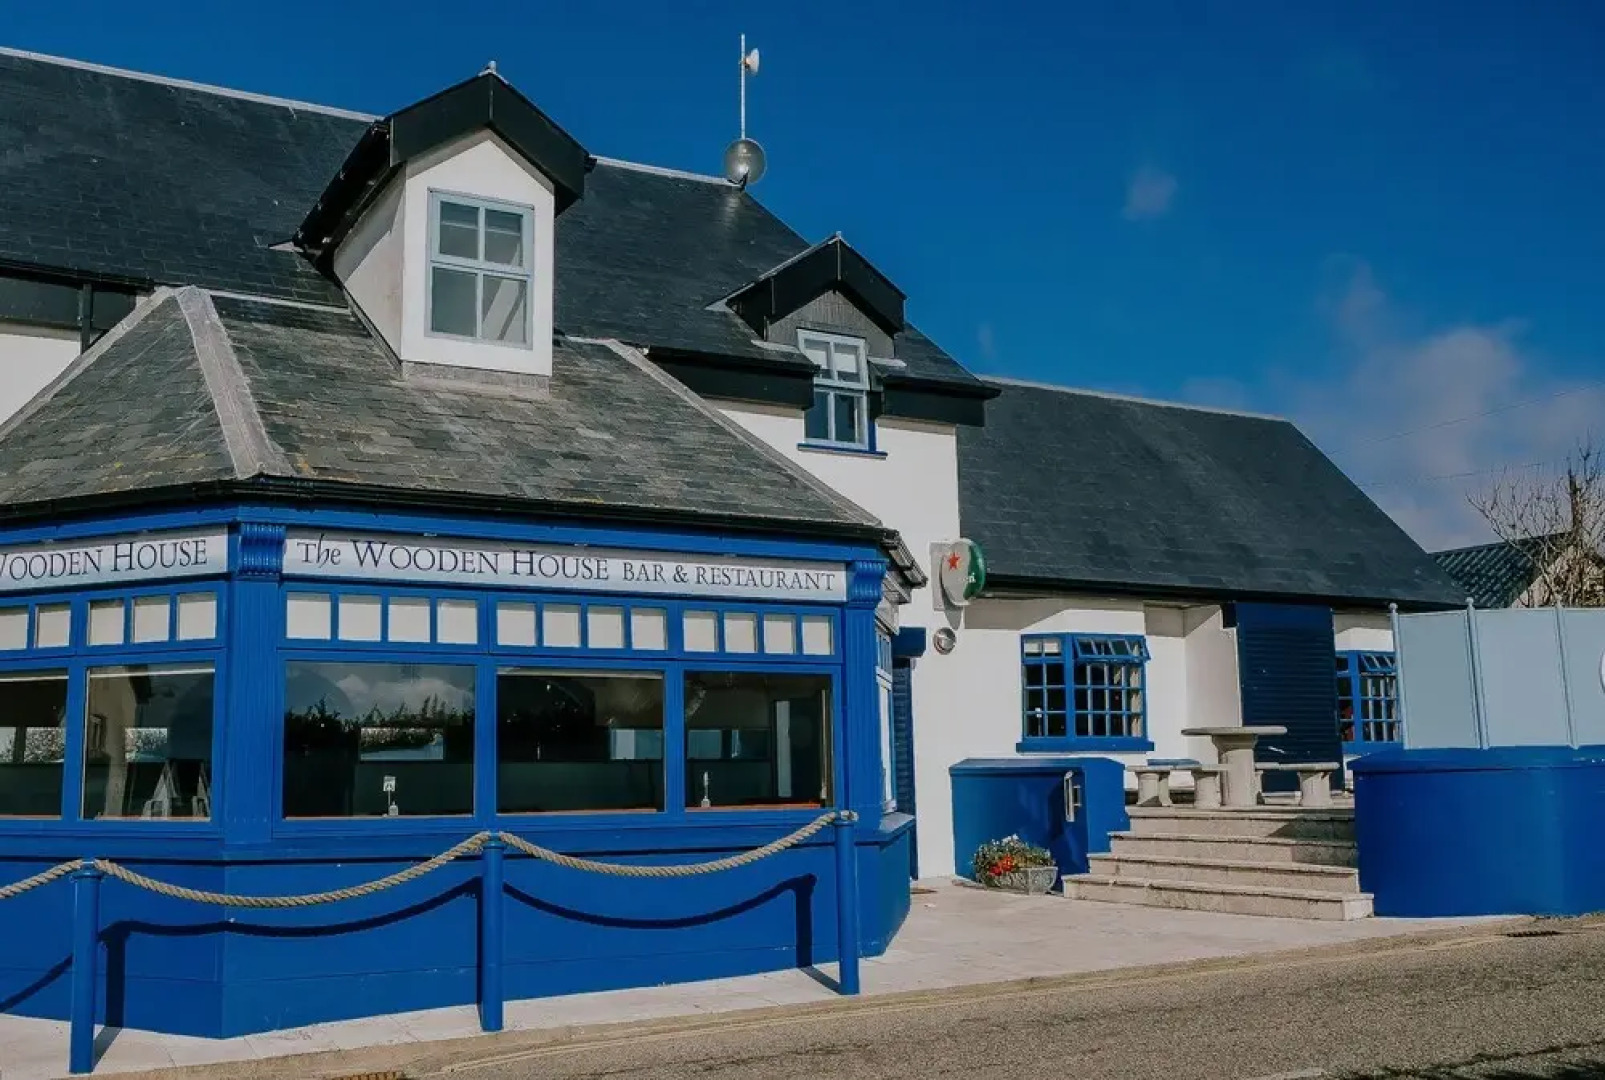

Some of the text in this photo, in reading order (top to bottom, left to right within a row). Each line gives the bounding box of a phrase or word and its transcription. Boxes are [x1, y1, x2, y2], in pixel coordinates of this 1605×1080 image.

[0, 538, 207, 581] OODEN HOUSE
[298, 533, 835, 591] The WOODEN HOUSE BAR & RESTAURANT
